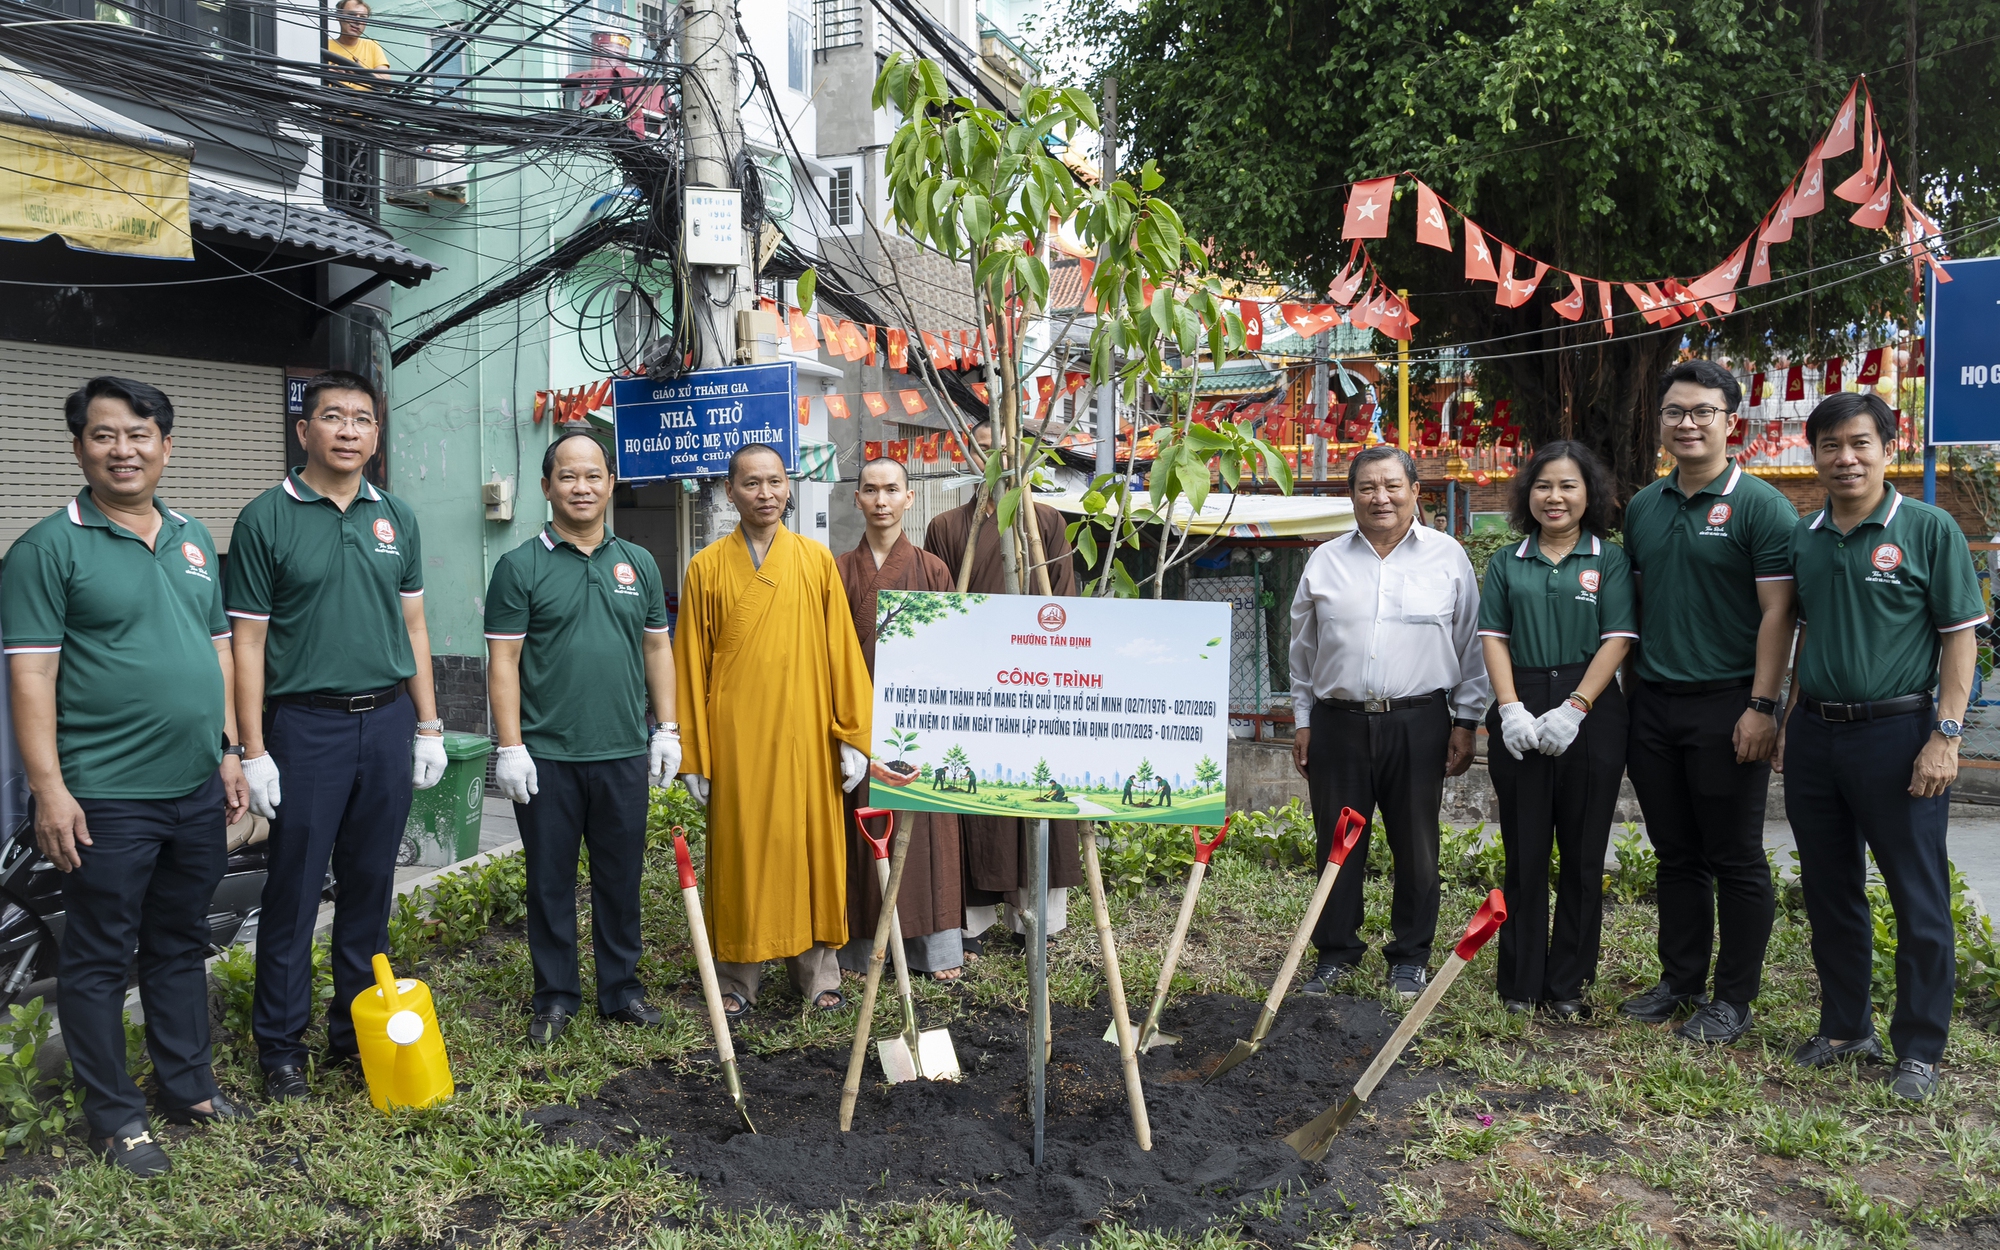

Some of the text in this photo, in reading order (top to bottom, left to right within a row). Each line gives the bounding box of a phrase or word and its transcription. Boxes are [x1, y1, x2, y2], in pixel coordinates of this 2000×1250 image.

[1961, 365, 1988, 388] HỌ
[652, 382, 749, 400] GIÁO XỨ THÁNH GIA
[660, 401, 744, 429] NHÀ THỜ
[625, 422, 783, 456] HỌ GIÁO ĐỨC MẸ VÔ NHIỄM
[671, 450, 698, 464] (XÓM
[1010, 633, 1091, 649] PHƯỜNG TÂN ĐỊNH
[996, 667, 1103, 689] CÔNG TRÌNH
[884, 683, 895, 702] KỶ
[896, 685, 916, 706] NIỆM
[918, 689, 927, 704] 50
[930, 686, 947, 705] NĂM
[950, 688, 974, 706] THÀNH
[976, 686, 993, 707] PHỐ
[994, 692, 1016, 708] MANG
[1019, 690, 1033, 709] TÊN
[1036, 689, 1050, 710] CHỦ
[1054, 694, 1071, 713] TỊCH
[1073, 691, 1084, 711] HỒ
[1086, 693, 1100, 712] CHÍ
[1101, 696, 1122, 712] MINH
[1124, 698, 1166, 715] (02/7/1976
[1174, 700, 1216, 718] 02/7/2026)
[895, 710, 905, 728] VÀ
[907, 709, 918, 728] KỶ
[919, 712, 939, 732] NIỆM
[940, 715, 950, 730] 01
[952, 713, 970, 731] NĂM
[972, 714, 993, 732] NGÀY
[995, 716, 1020, 733] THÀNH
[1022, 716, 1037, 737] LẬP
[1039, 717, 1070, 736] PHƯỜNG
[1073, 718, 1087, 737] TÂN
[1090, 722, 1109, 740] ĐỊNH
[1111, 722, 1152, 739] (01/7/2025
[1161, 724, 1203, 742] 01/7/2026)
